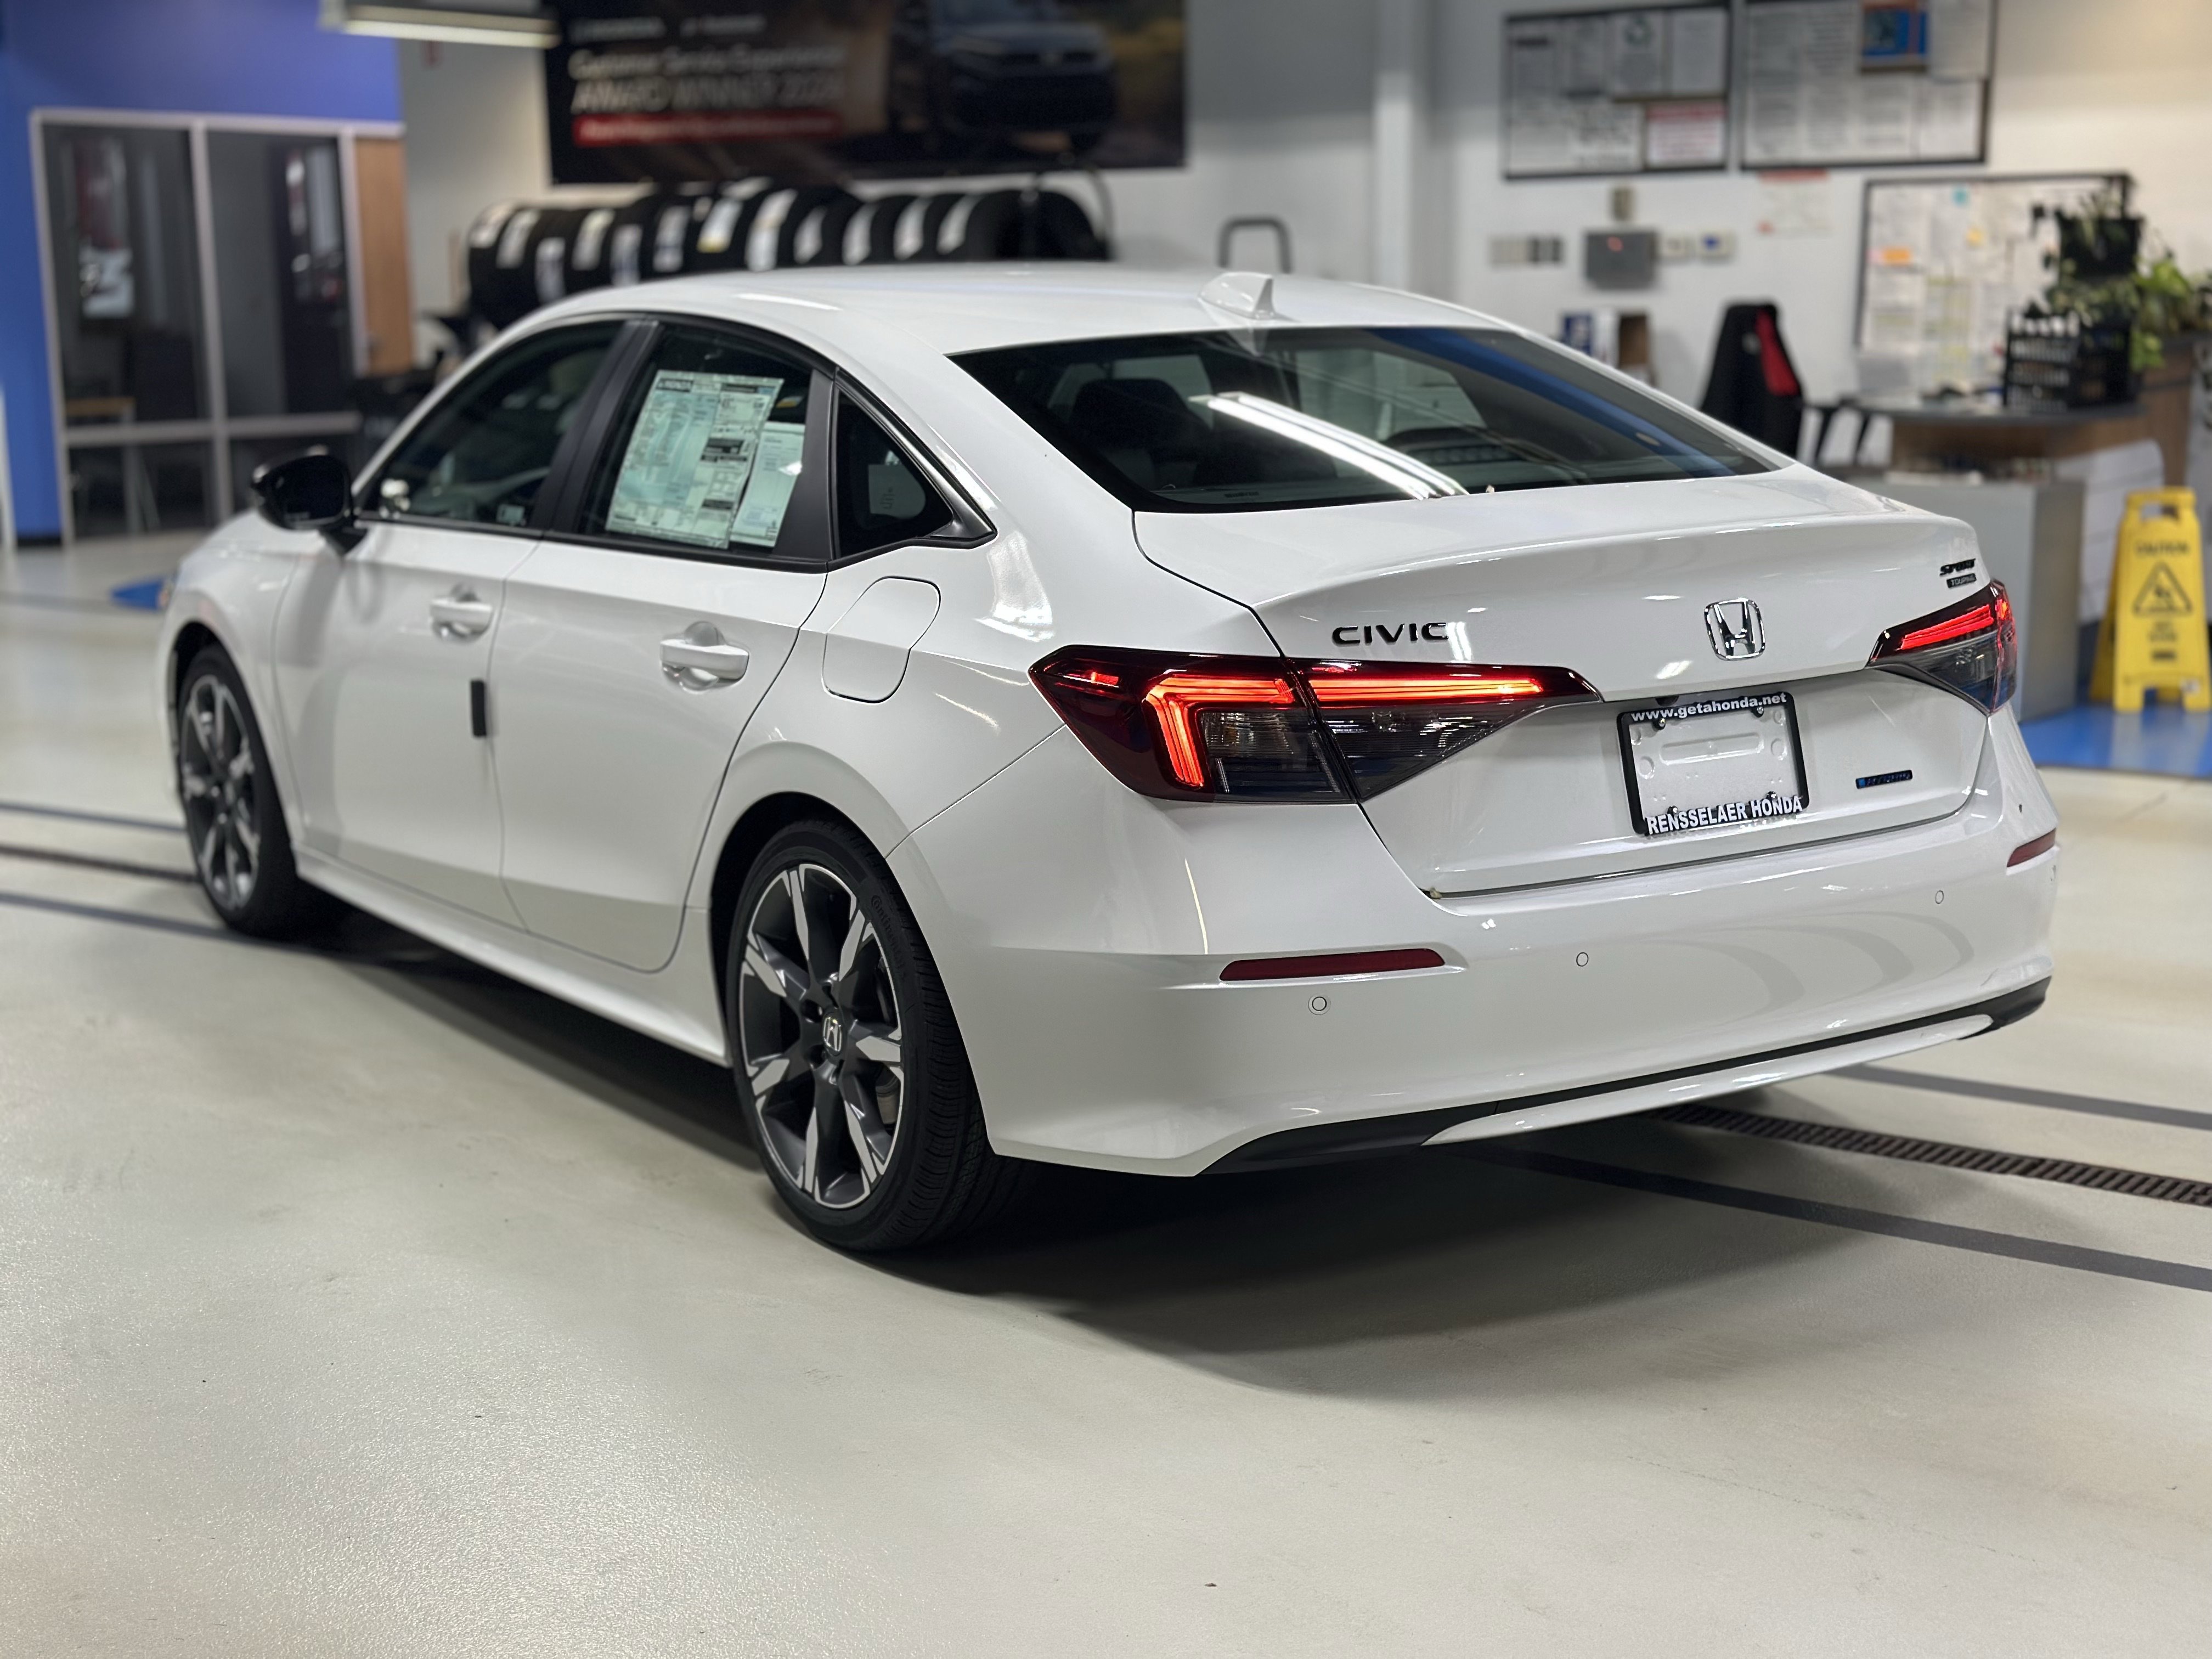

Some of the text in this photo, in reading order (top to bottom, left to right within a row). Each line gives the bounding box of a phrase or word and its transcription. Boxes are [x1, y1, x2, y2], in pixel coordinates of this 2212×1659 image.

[1332, 622, 1449, 645] CIVIC
[1631, 692, 1787, 722] www.getahonda.net
[1646, 795, 1803, 835] RENSSELAER HONDA
